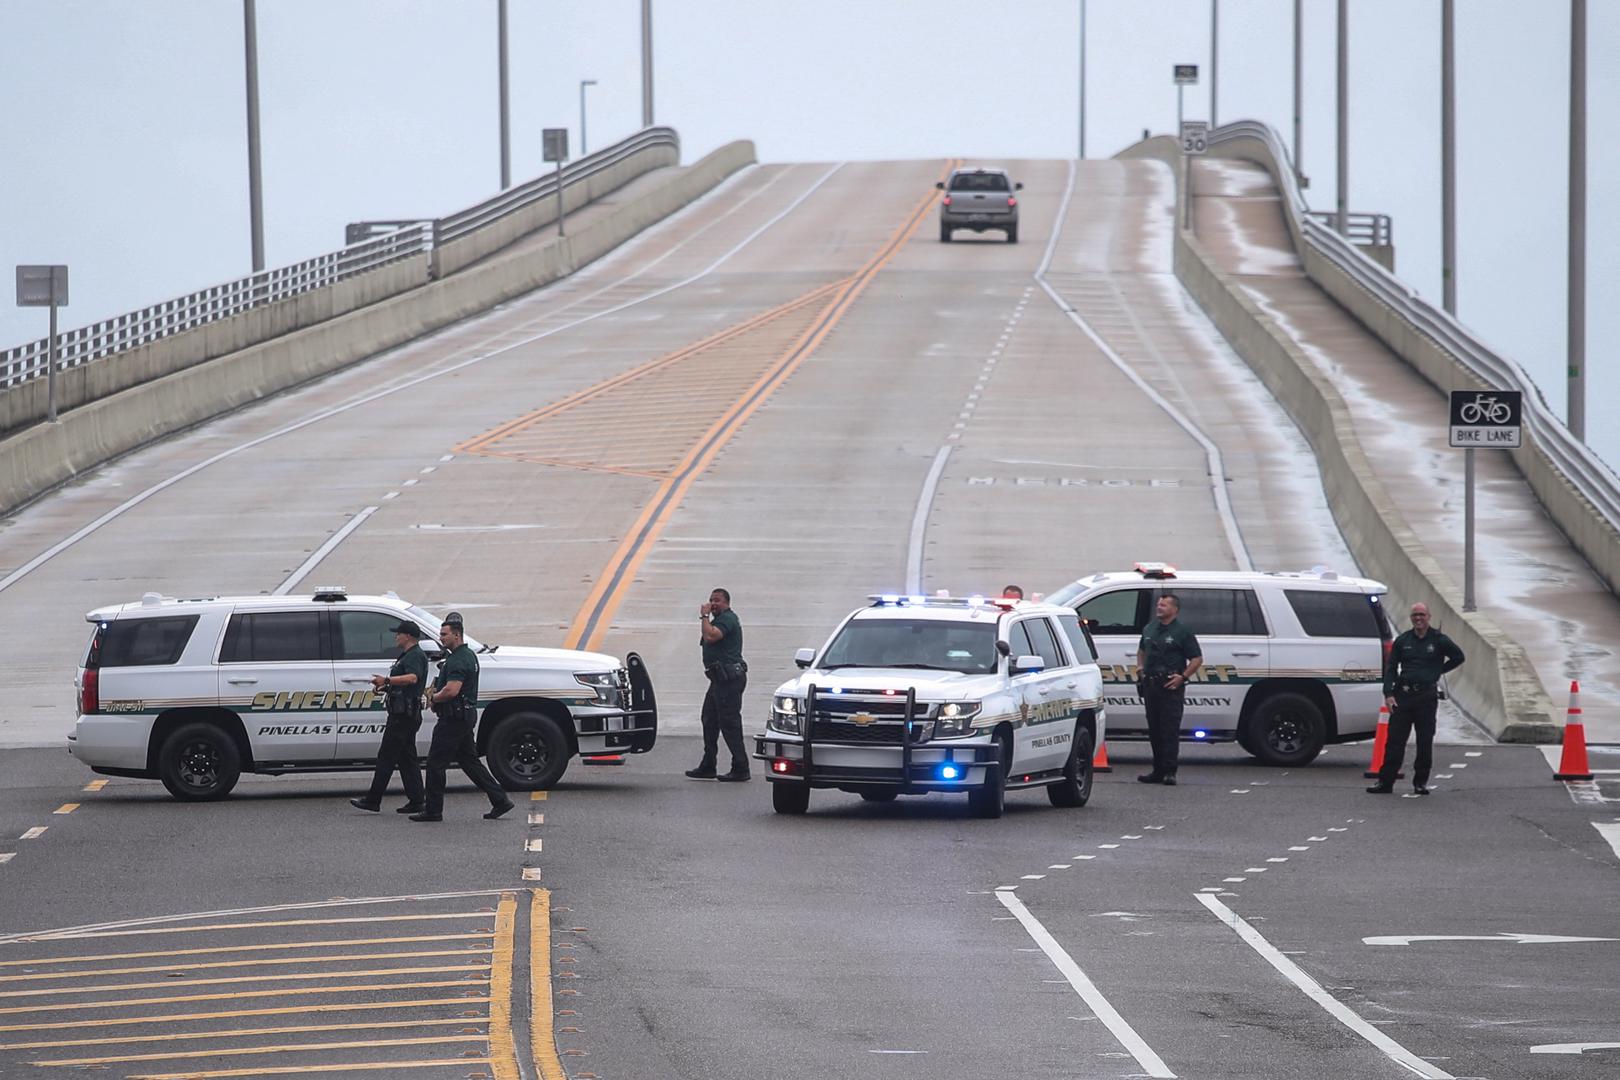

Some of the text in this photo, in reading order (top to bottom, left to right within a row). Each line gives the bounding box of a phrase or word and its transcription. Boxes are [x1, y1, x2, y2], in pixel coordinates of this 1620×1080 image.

[1184, 139, 1207, 152] 30
[1457, 430, 1513, 441] BIKE LANE
[967, 477, 1181, 487] MERGE
[1100, 664, 1236, 683] SHIFF
[252, 691, 386, 710] SHERIF
[1103, 697, 1231, 706] INELL OUNTY
[1031, 698, 1072, 723] SHERIFF
[258, 725, 387, 735] PINELLAS COUNT
[1053, 733, 1071, 745] COUNTY
